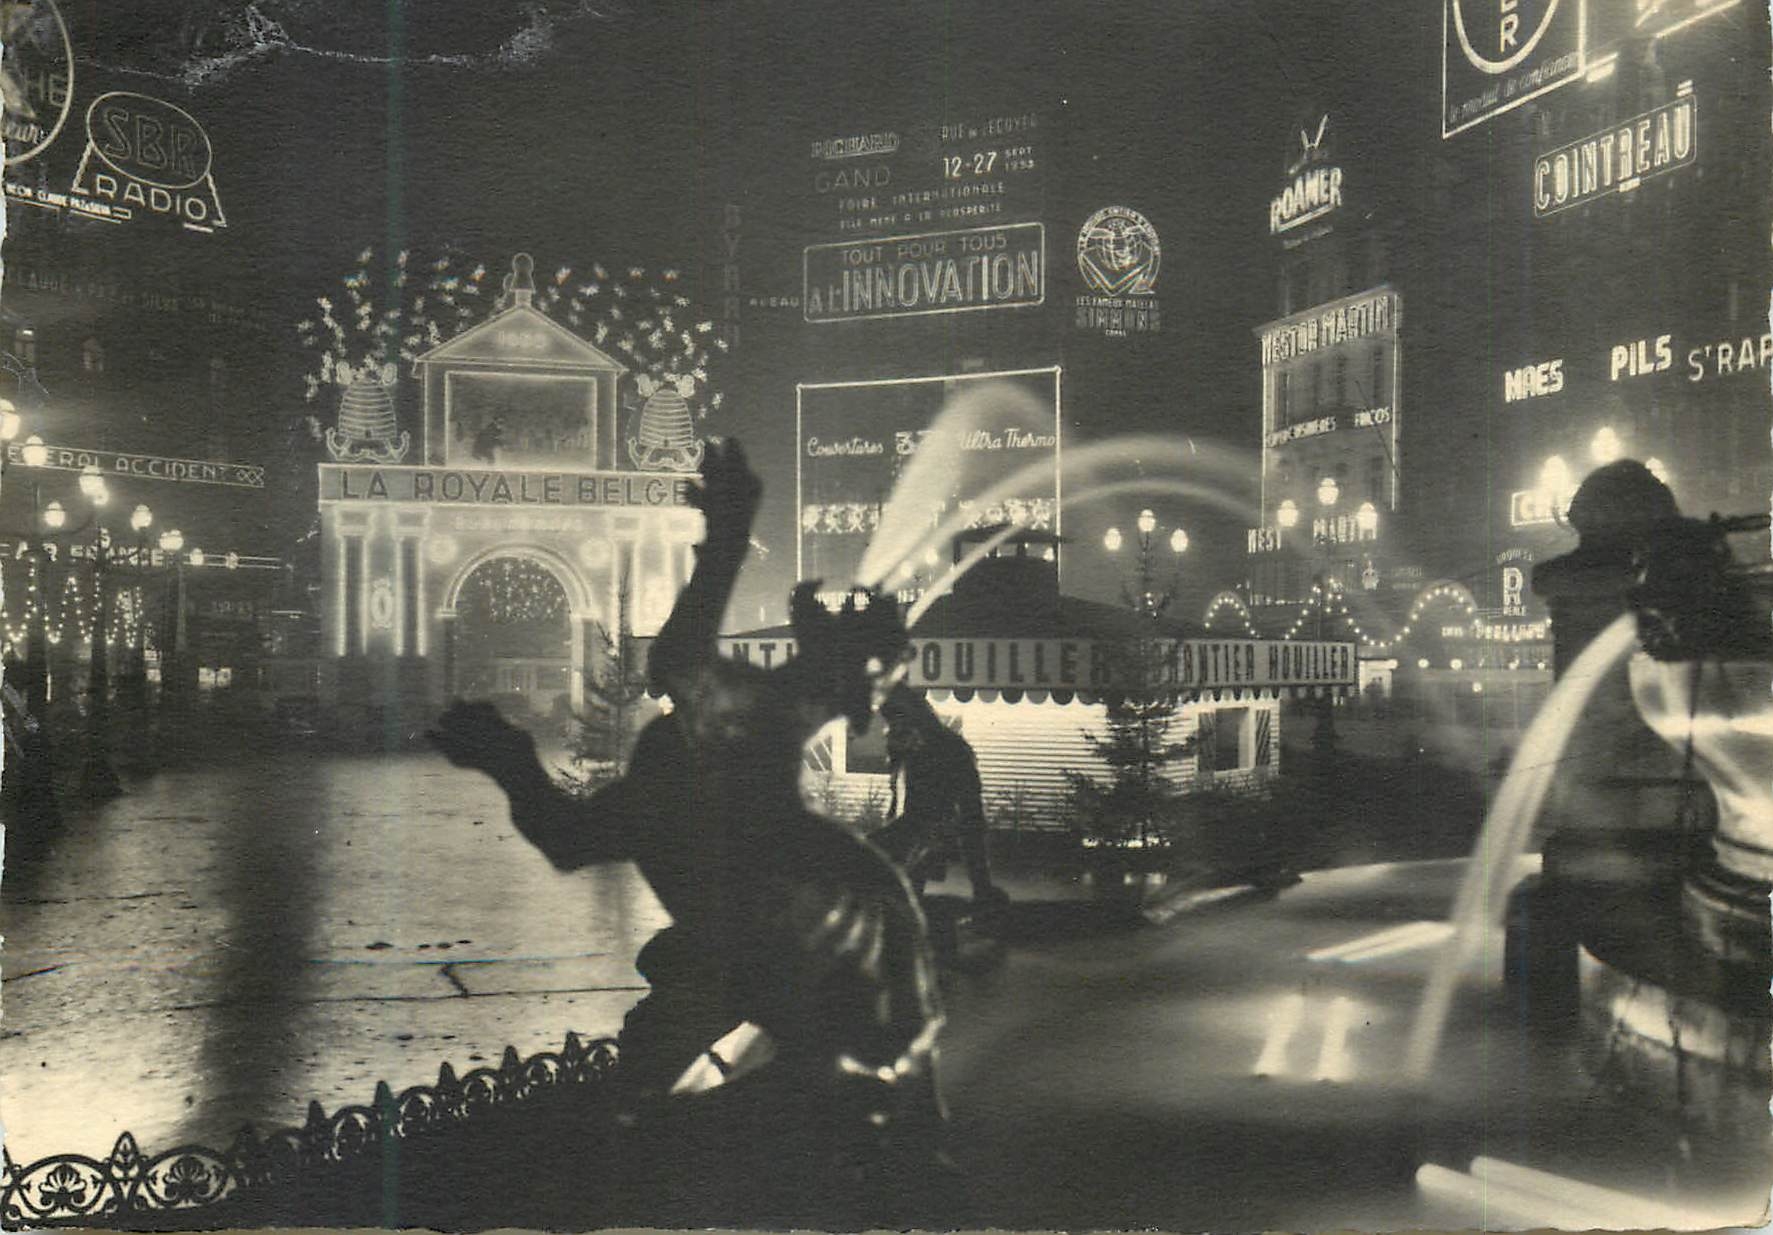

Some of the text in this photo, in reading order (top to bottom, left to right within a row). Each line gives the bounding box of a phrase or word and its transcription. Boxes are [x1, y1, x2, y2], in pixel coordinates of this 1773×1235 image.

[103, 107, 197, 180] SBR
[1536, 102, 1691, 211] COINTREAU
[815, 166, 891, 194] GAND
[943, 151, 997, 178] 12-27
[96, 174, 207, 221] RADIO
[1269, 167, 1343, 236] ROAMER
[841, 233, 1008, 266] TOUT POUR TOUS
[1504, 333, 1672, 401] MAES PILS
[1004, 428, 1057, 449] Thermo
[342, 471, 690, 506] LA ROYALE BELGE
[1268, 644, 1350, 682] HOUILLER
